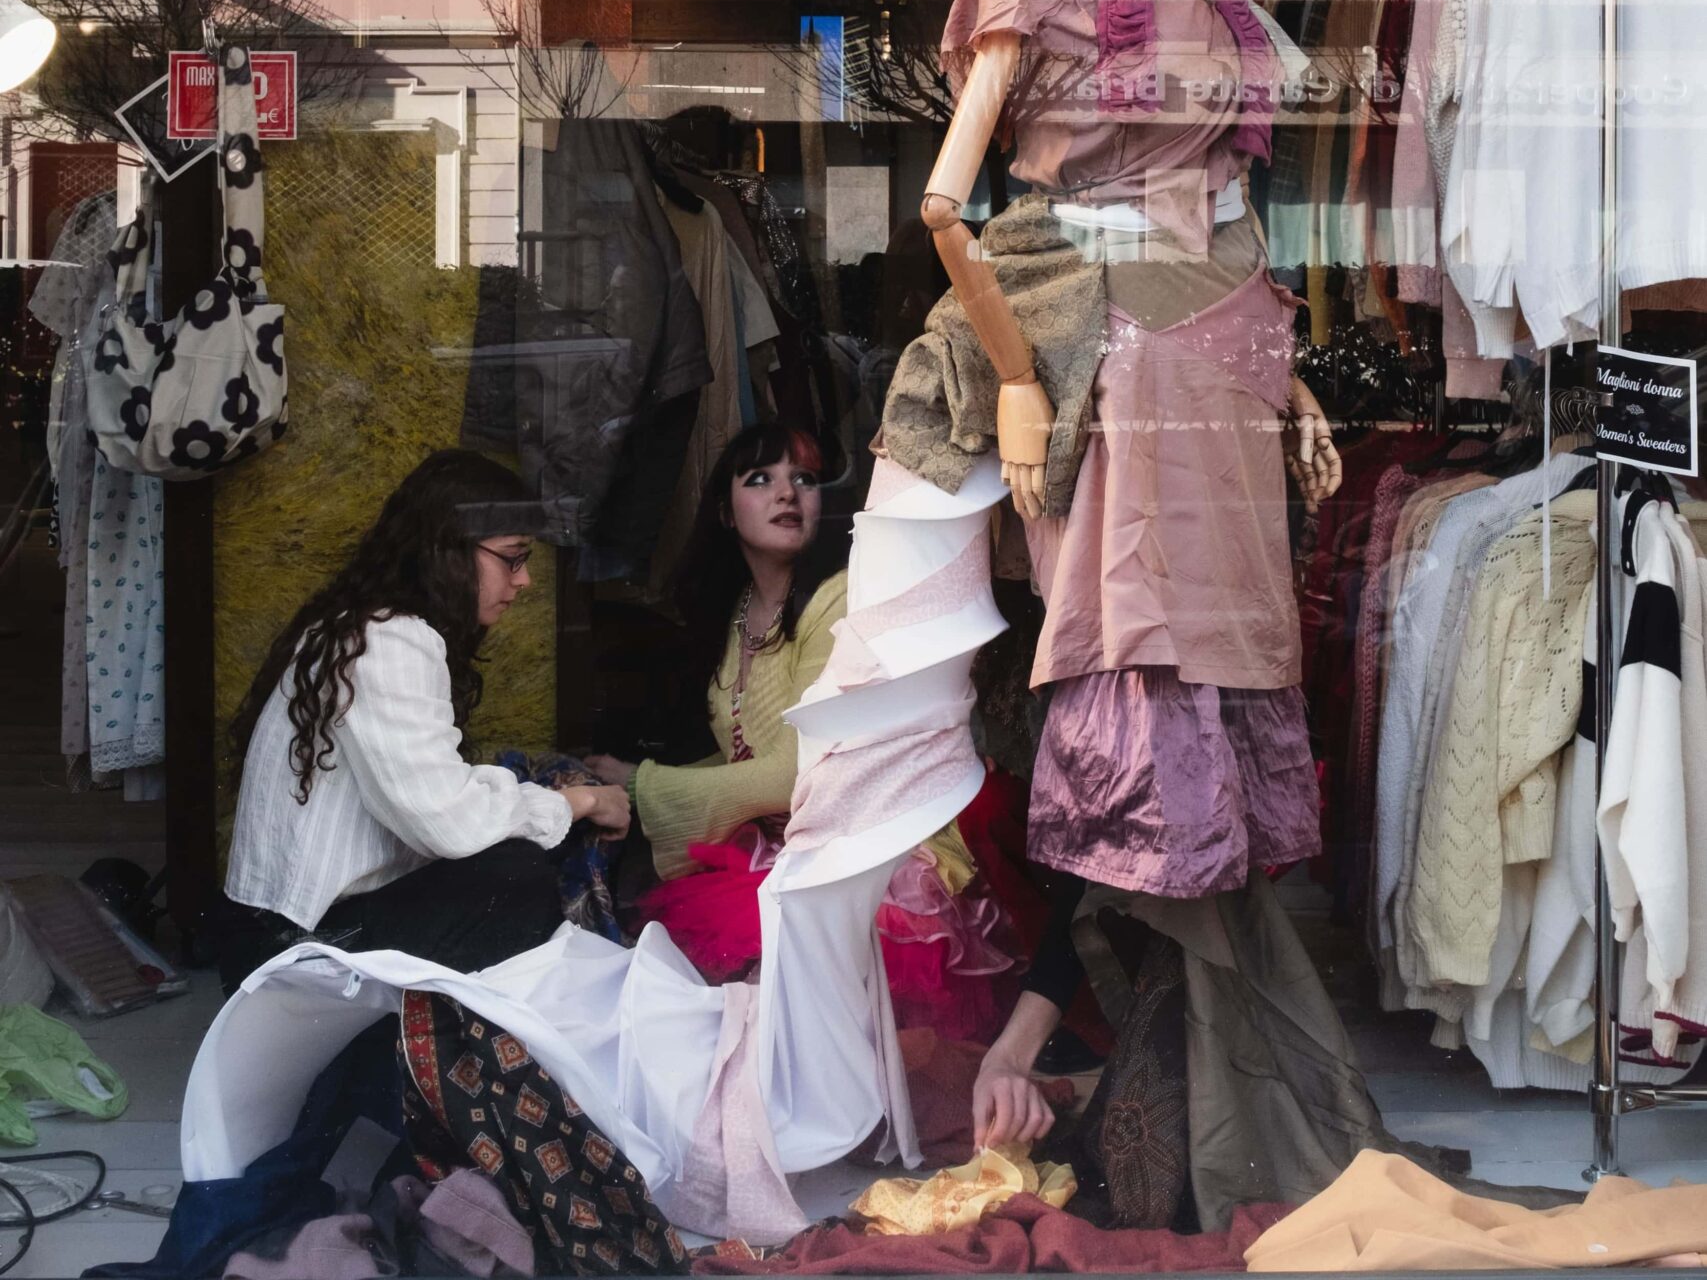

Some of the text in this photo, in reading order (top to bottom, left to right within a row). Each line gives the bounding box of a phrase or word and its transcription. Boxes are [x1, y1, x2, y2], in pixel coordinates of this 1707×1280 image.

[186, 66, 215, 87] MAX
[1596, 367, 1684, 399] Maglioni donna
[1636, 431, 1688, 455] Sweaters
